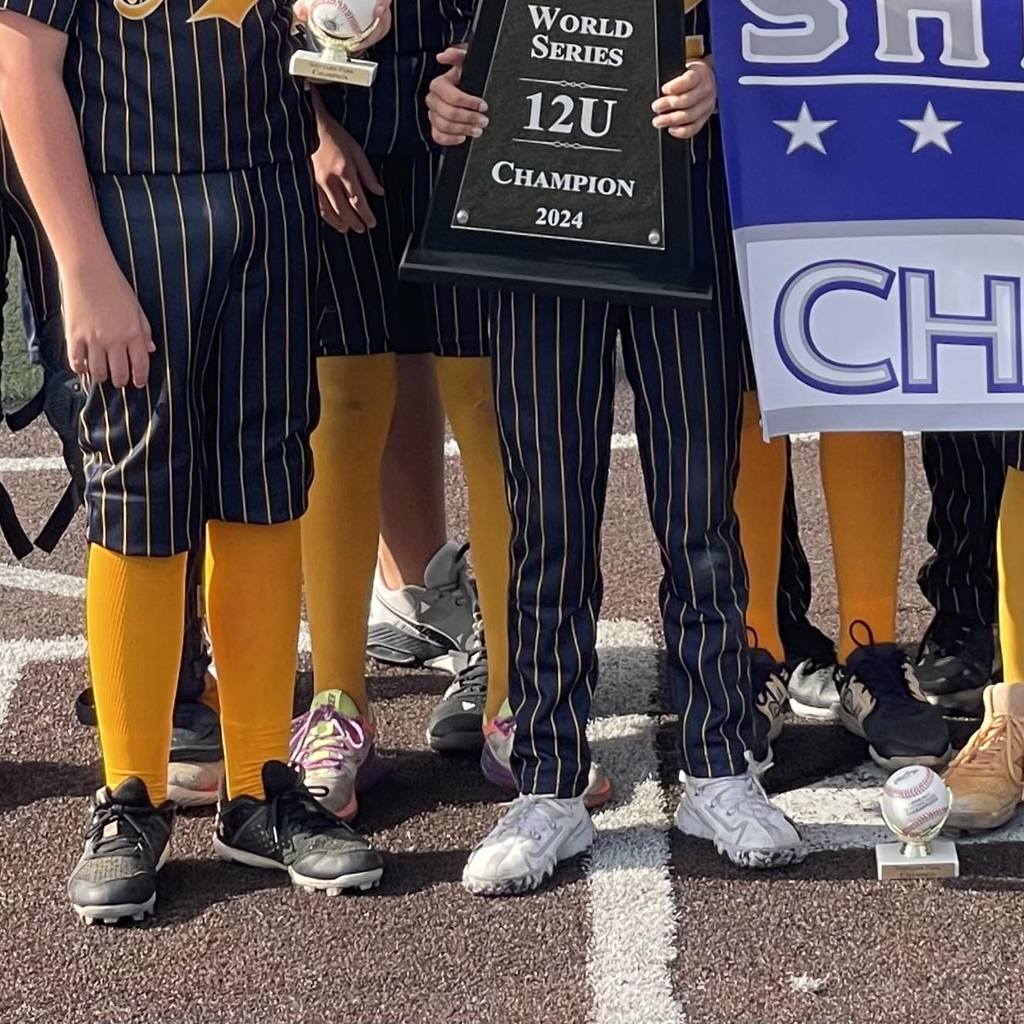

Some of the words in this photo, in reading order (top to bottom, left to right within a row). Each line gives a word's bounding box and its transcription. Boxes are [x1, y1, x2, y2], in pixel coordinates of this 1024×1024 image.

[527, 4, 633, 41] WORLD
[530, 34, 624, 67] SERIES
[523, 91, 618, 138] 12U
[490, 161, 636, 198] CHAMPION
[535, 207, 584, 230] 2024
